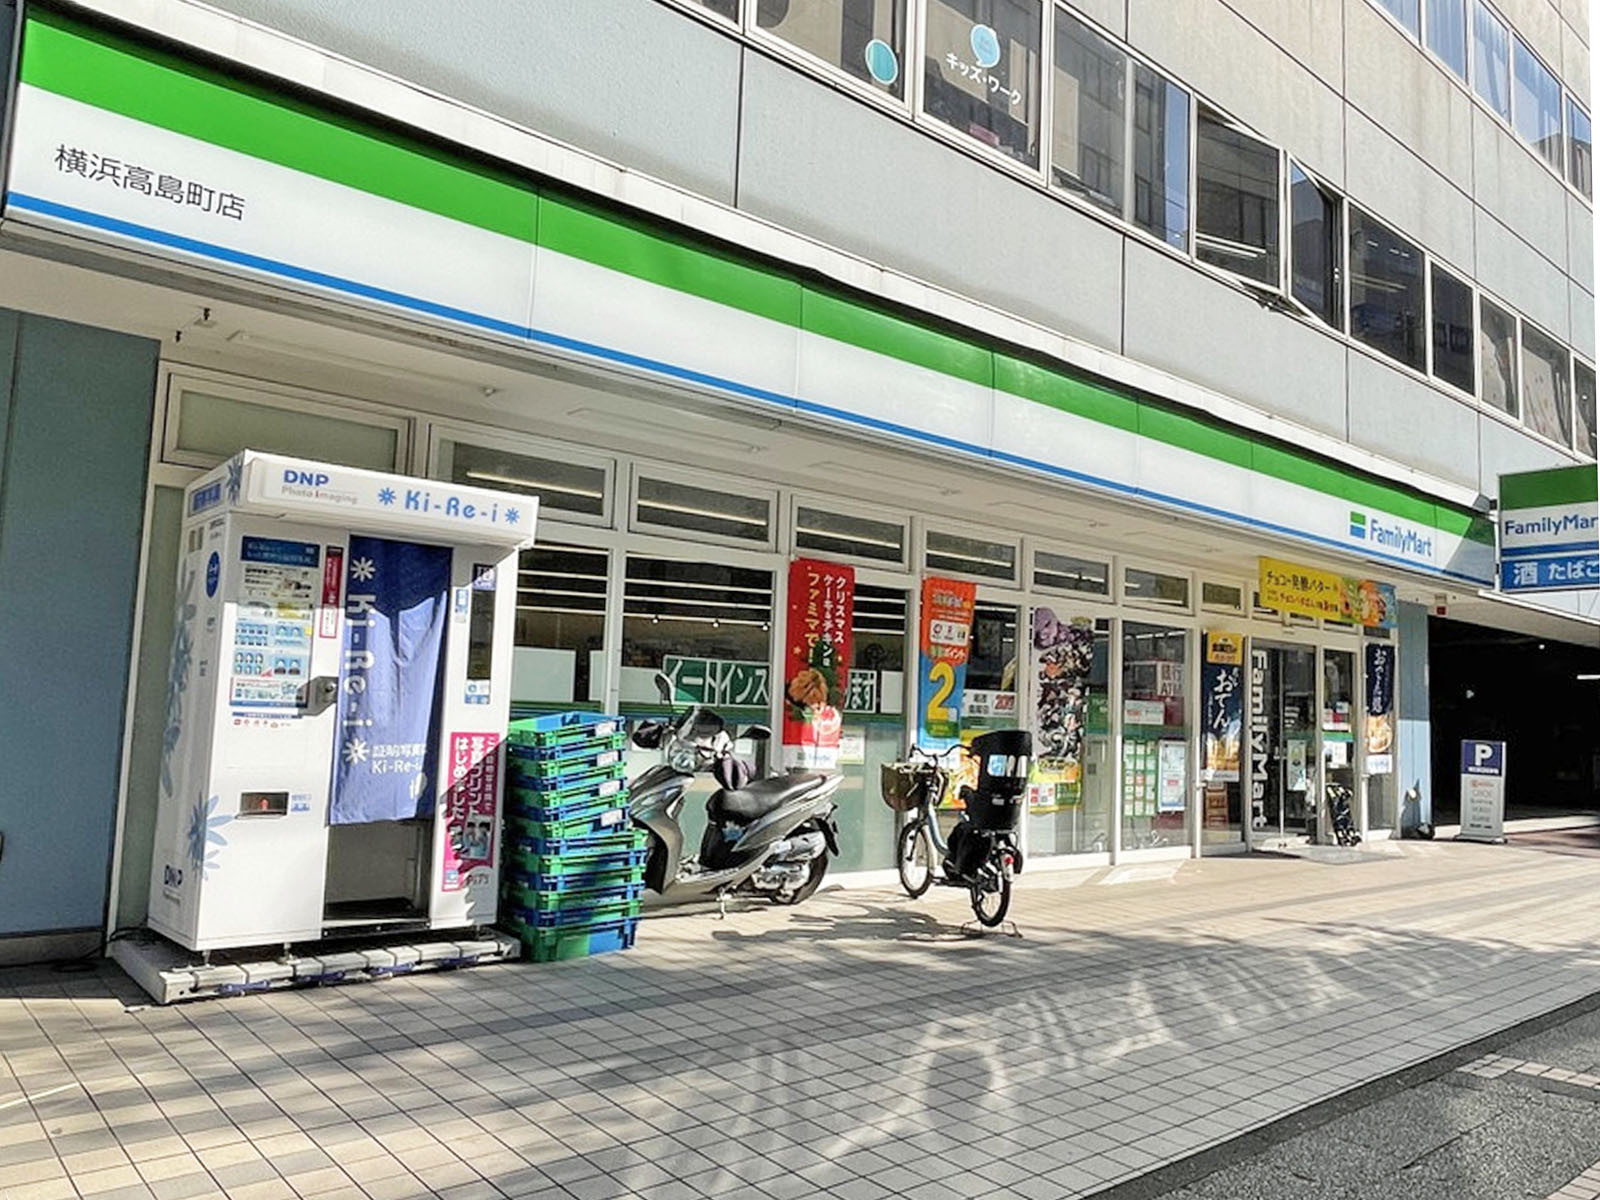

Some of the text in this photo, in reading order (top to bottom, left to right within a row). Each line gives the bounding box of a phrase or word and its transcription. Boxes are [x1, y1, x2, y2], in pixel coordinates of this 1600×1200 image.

[945, 53, 1022, 105] キッズ・ワーク
[55, 144, 246, 221] 横浜高島町店
[281, 486, 358, 505] Photo Imaging
[283, 470, 329, 487] DNP
[405, 490, 497, 522] Ki-Re-i
[1370, 518, 1432, 557] FamilyMart
[1513, 560, 1599, 585] 酒 たばこ
[834, 577, 847, 644] クリスマス
[344, 594, 377, 727] Ki-Re-i
[927, 661, 956, 720] 2
[1251, 650, 1269, 828] FamilyMart
[1475, 744, 1493, 766] P
